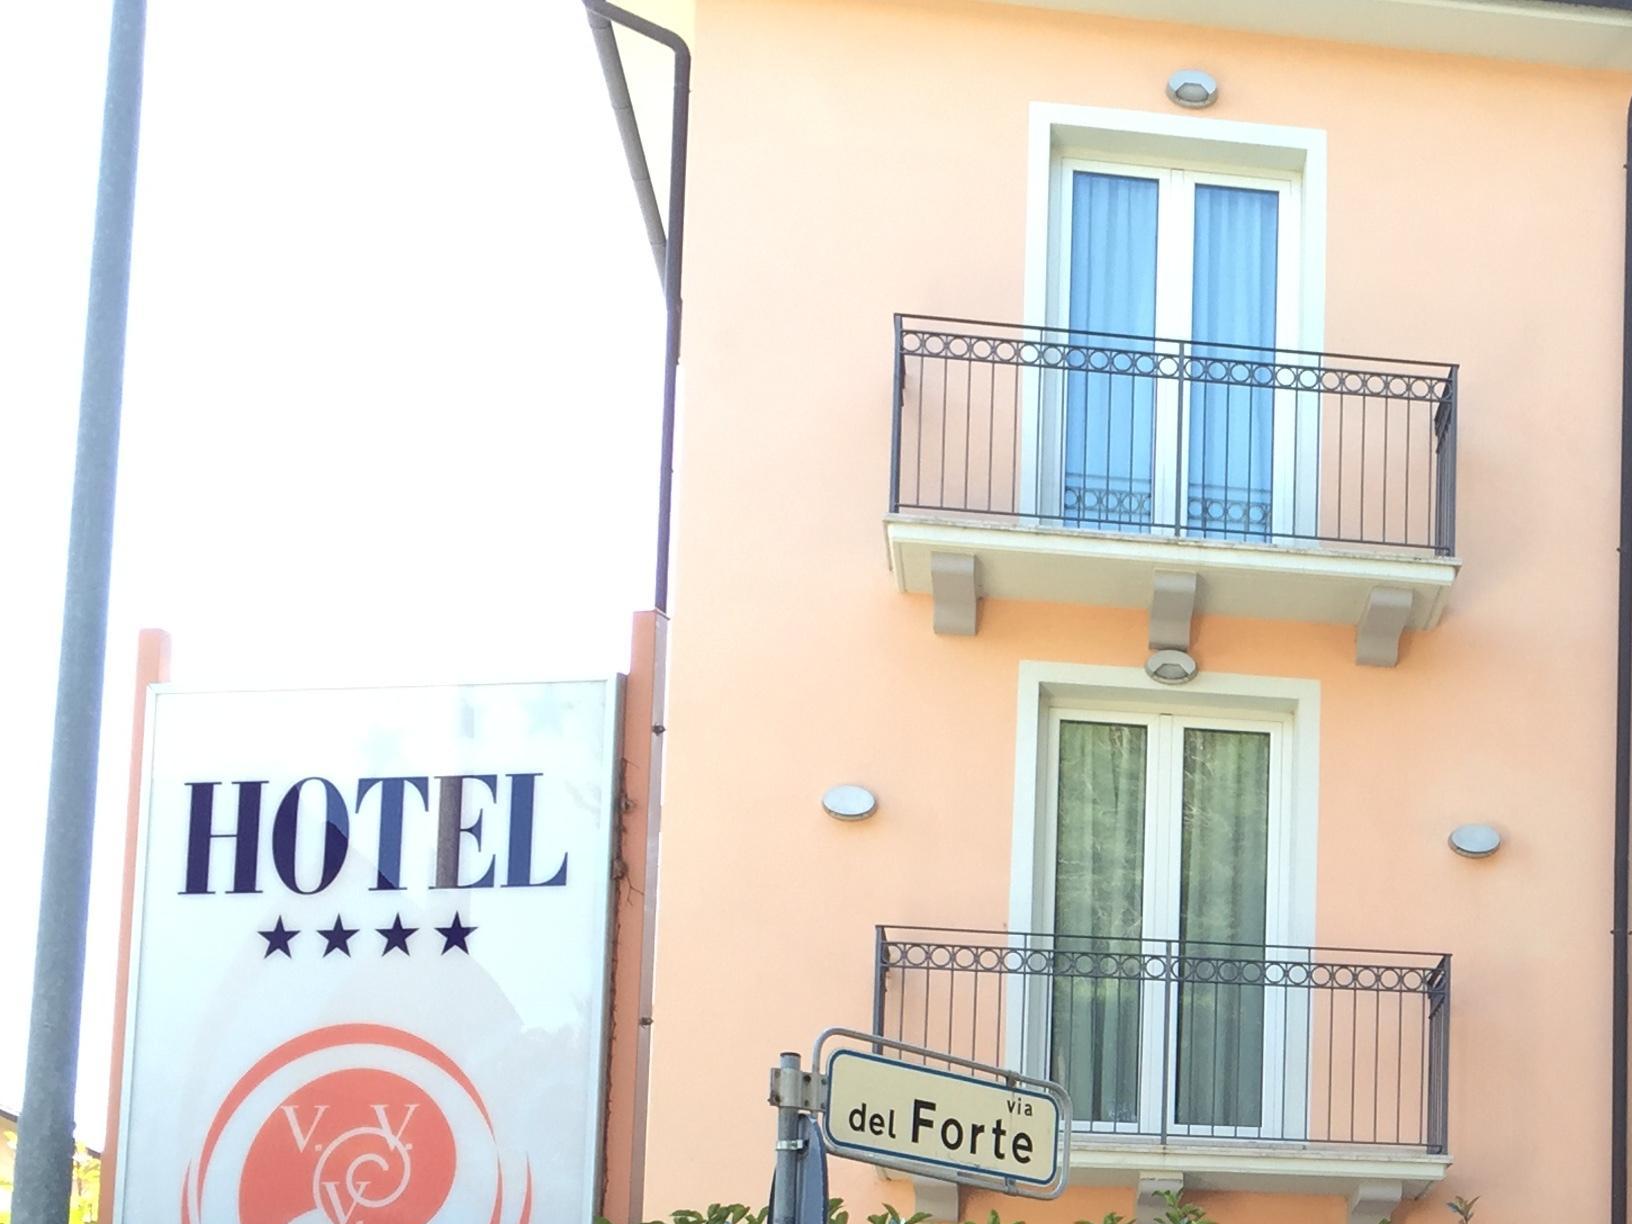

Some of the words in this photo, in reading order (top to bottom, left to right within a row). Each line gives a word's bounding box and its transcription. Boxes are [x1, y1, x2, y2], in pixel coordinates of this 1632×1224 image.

[177, 773, 568, 895] HOTEL
[848, 1102, 896, 1140] del
[911, 1098, 1034, 1164] Forte
[1006, 1098, 1033, 1117] via
